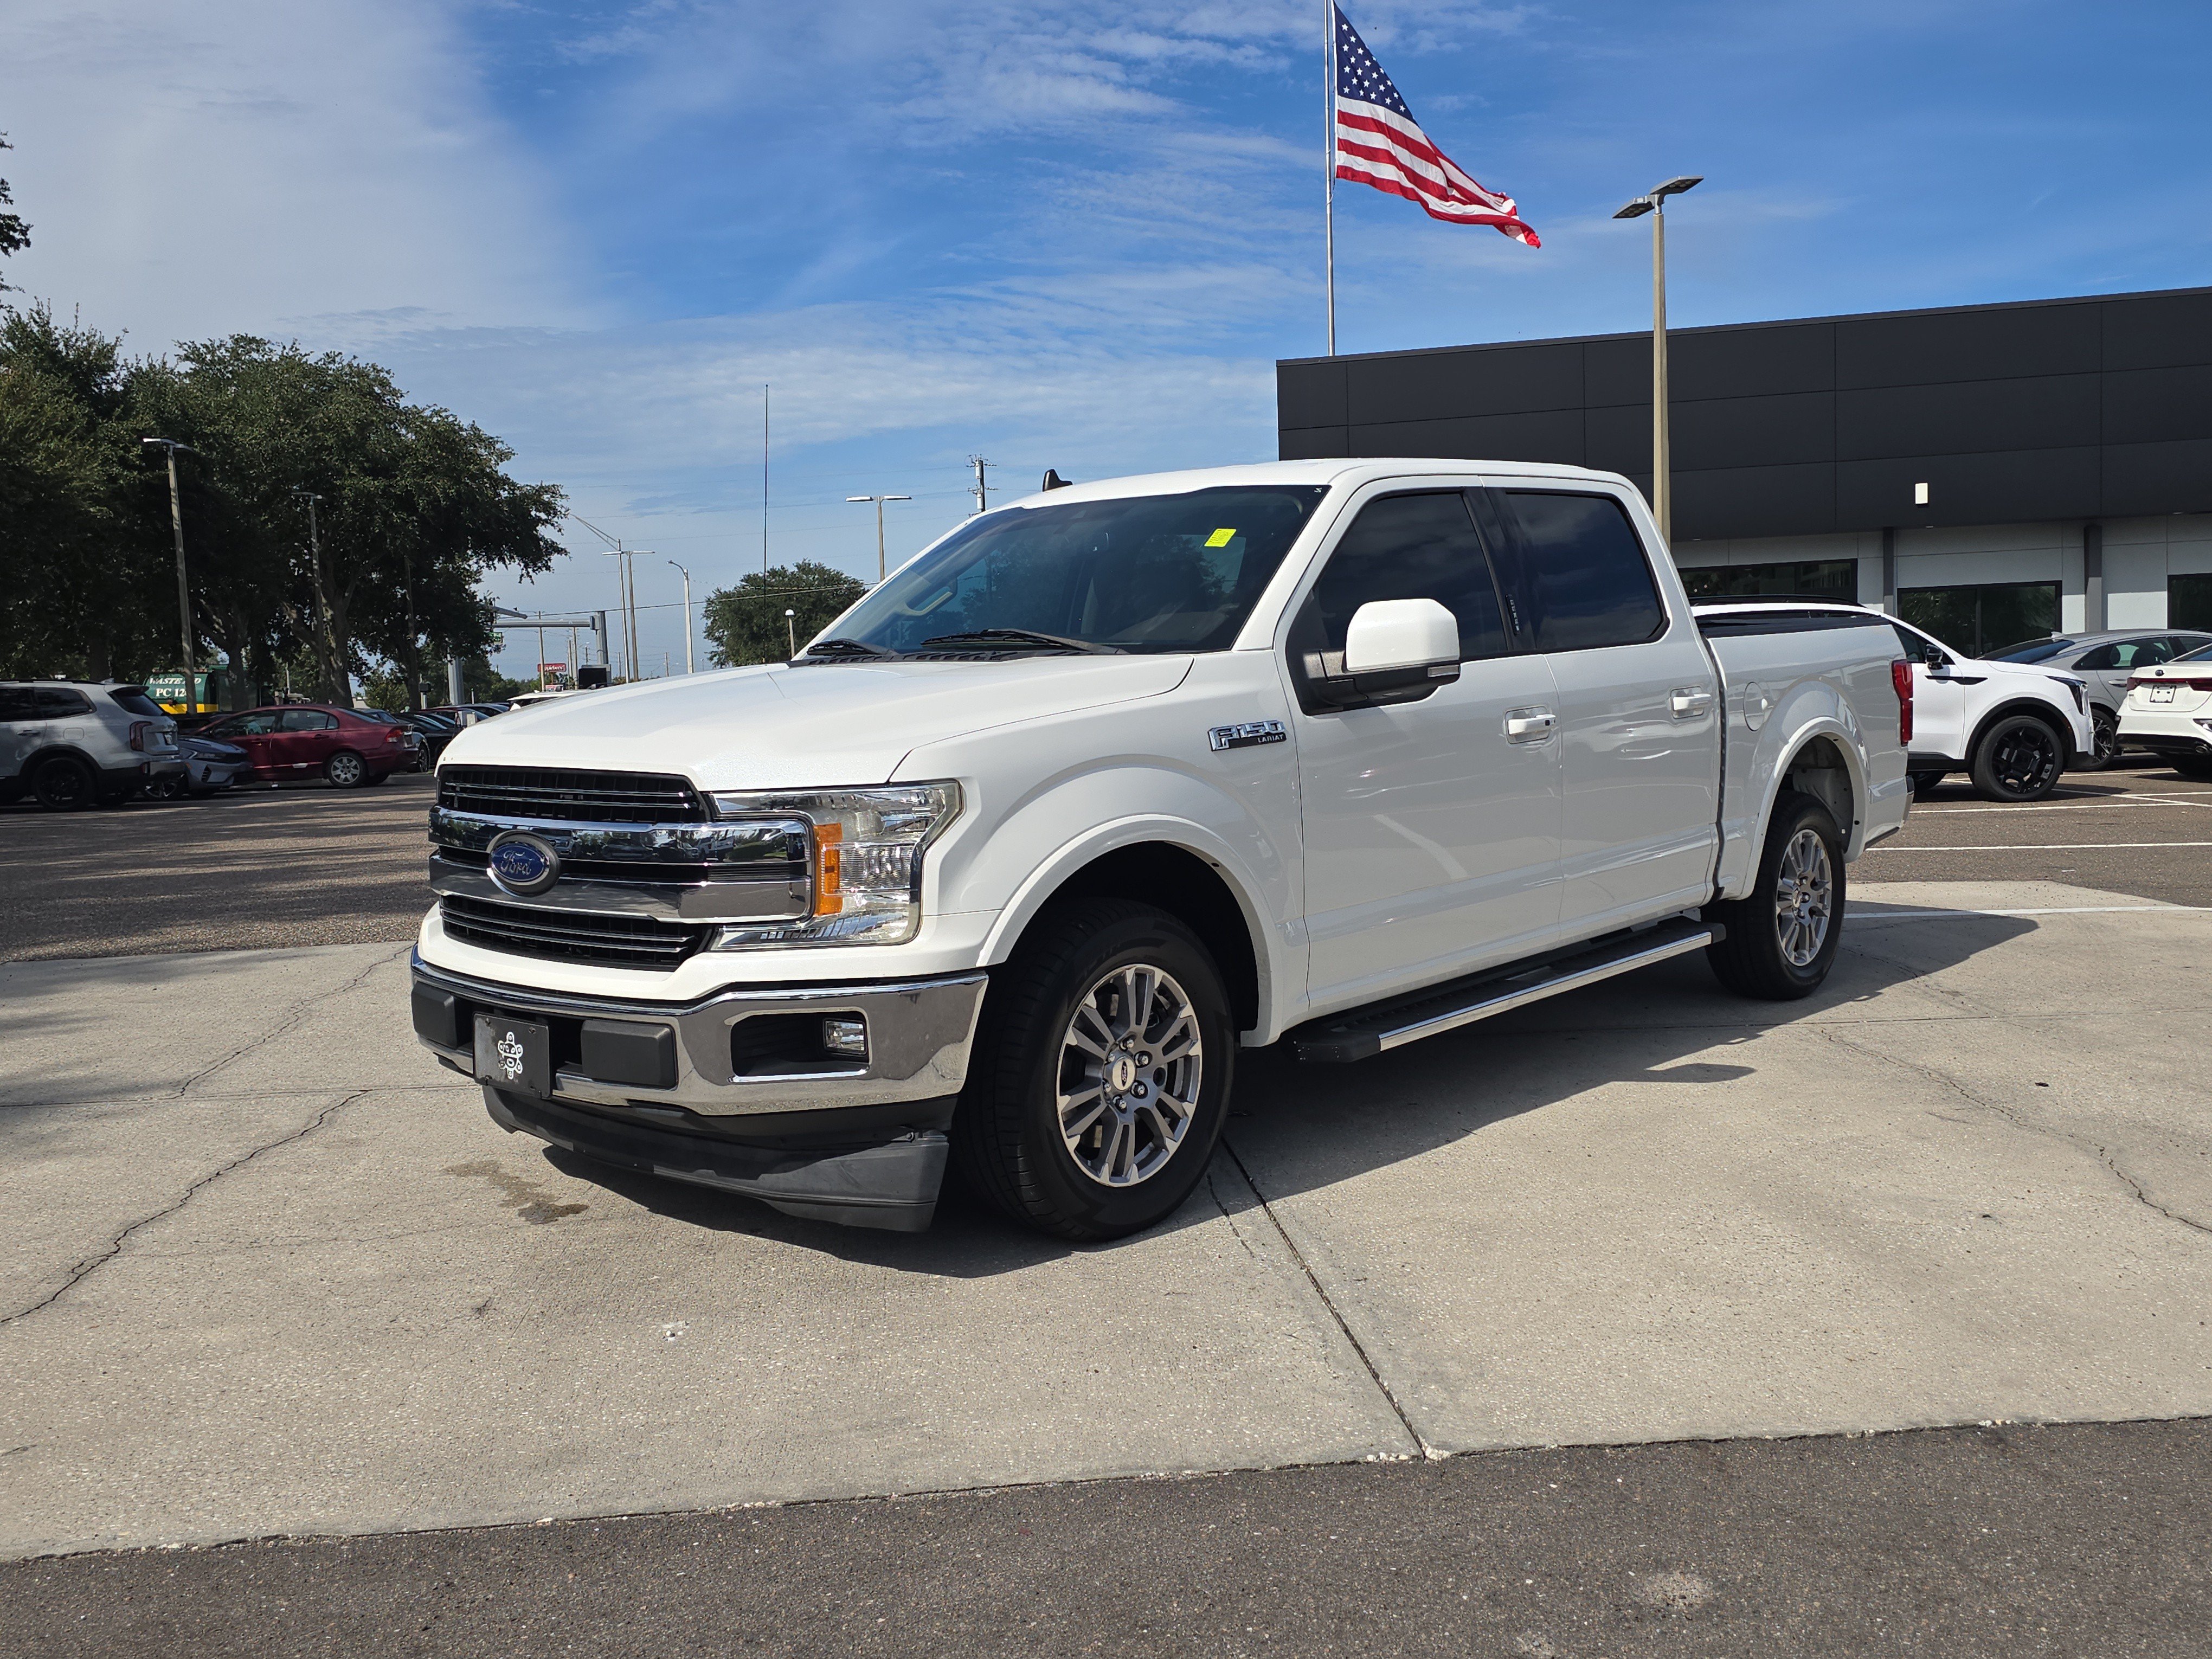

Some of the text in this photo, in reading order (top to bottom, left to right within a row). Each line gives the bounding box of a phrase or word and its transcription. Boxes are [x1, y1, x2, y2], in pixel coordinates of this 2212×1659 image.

[155, 688, 172, 697] PC
[1257, 734, 1284, 743] LARIAT
[500, 850, 533, 876] Ford
